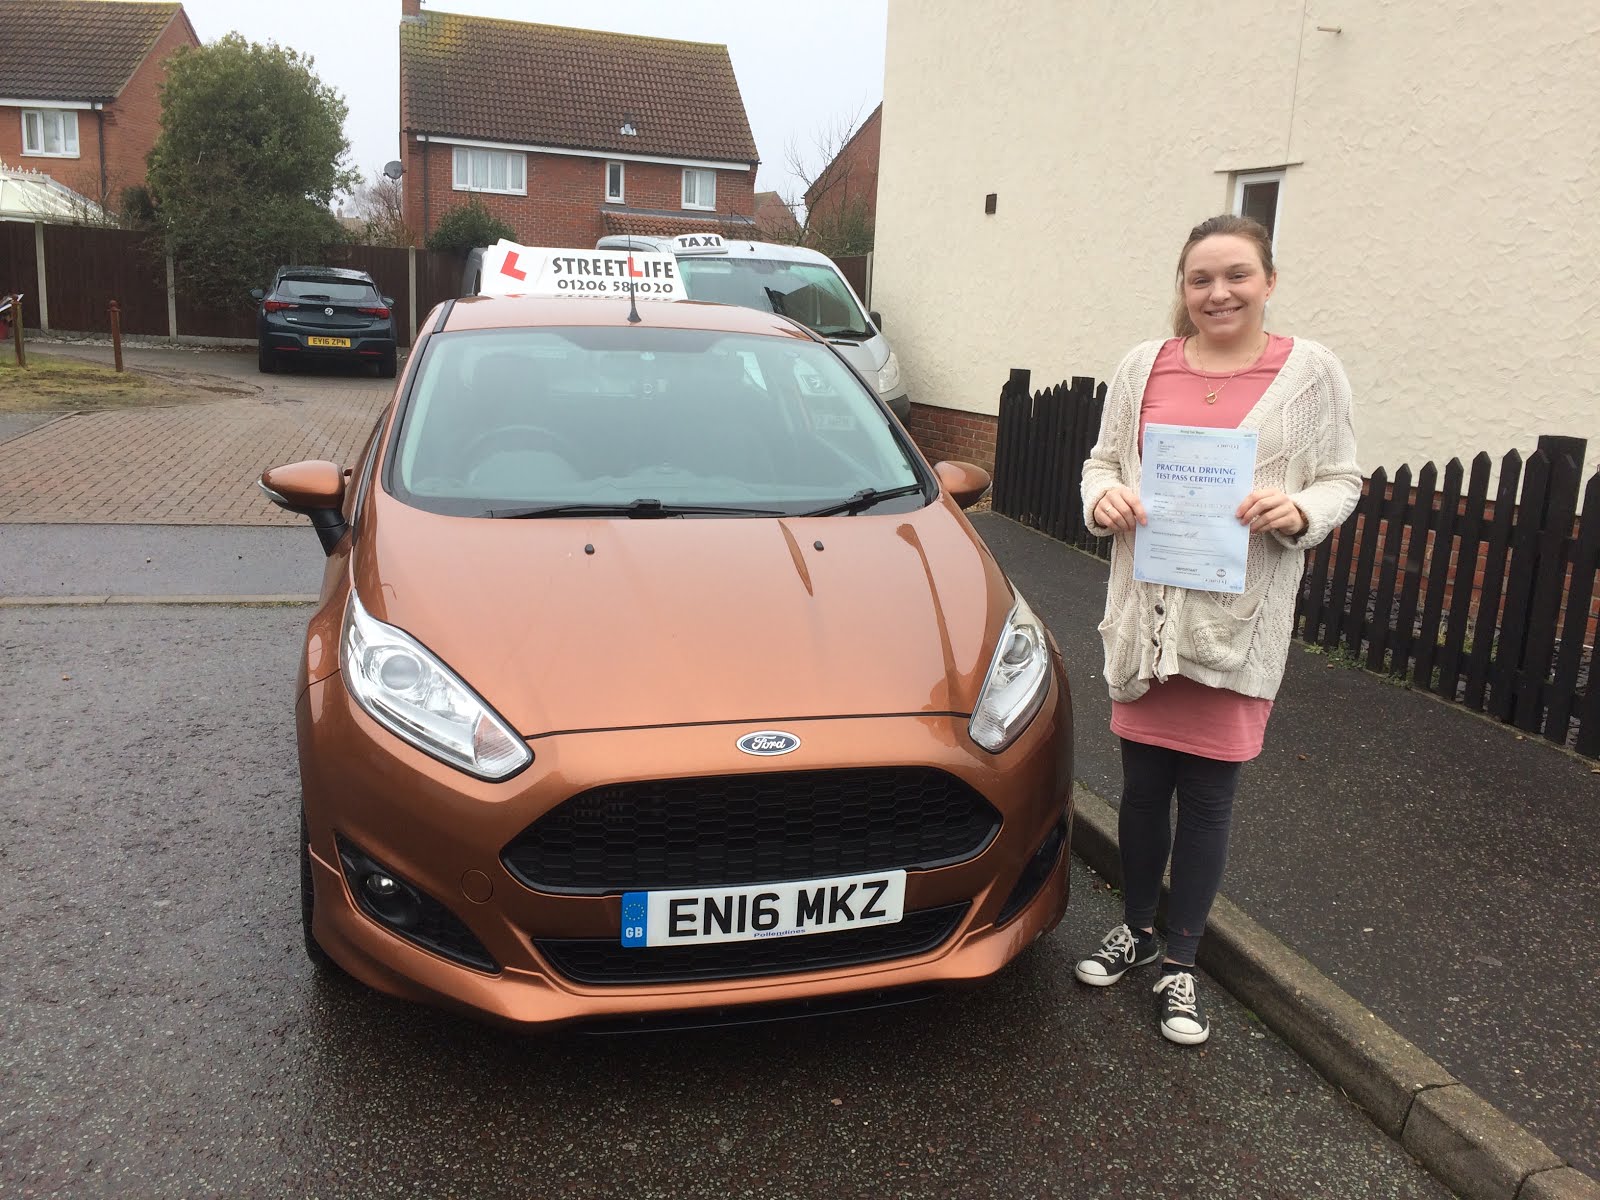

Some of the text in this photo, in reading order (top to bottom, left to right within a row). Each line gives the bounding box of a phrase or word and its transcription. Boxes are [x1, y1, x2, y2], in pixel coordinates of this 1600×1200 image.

[678, 236, 721, 247] TAXI
[501, 251, 527, 281] L
[552, 257, 674, 278] STREETLIFE
[557, 279, 673, 294] 01206 581020
[1156, 463, 1236, 476] PRACTICAL DRIVING
[1172, 473, 1188, 481] PASS
[1189, 475, 1236, 485] CERTIFICATE
[751, 735, 786, 750] Ford
[668, 879, 889, 938] EN16 MKZ
[625, 926, 643, 938] GB
[753, 928, 806, 938] Pollendines
